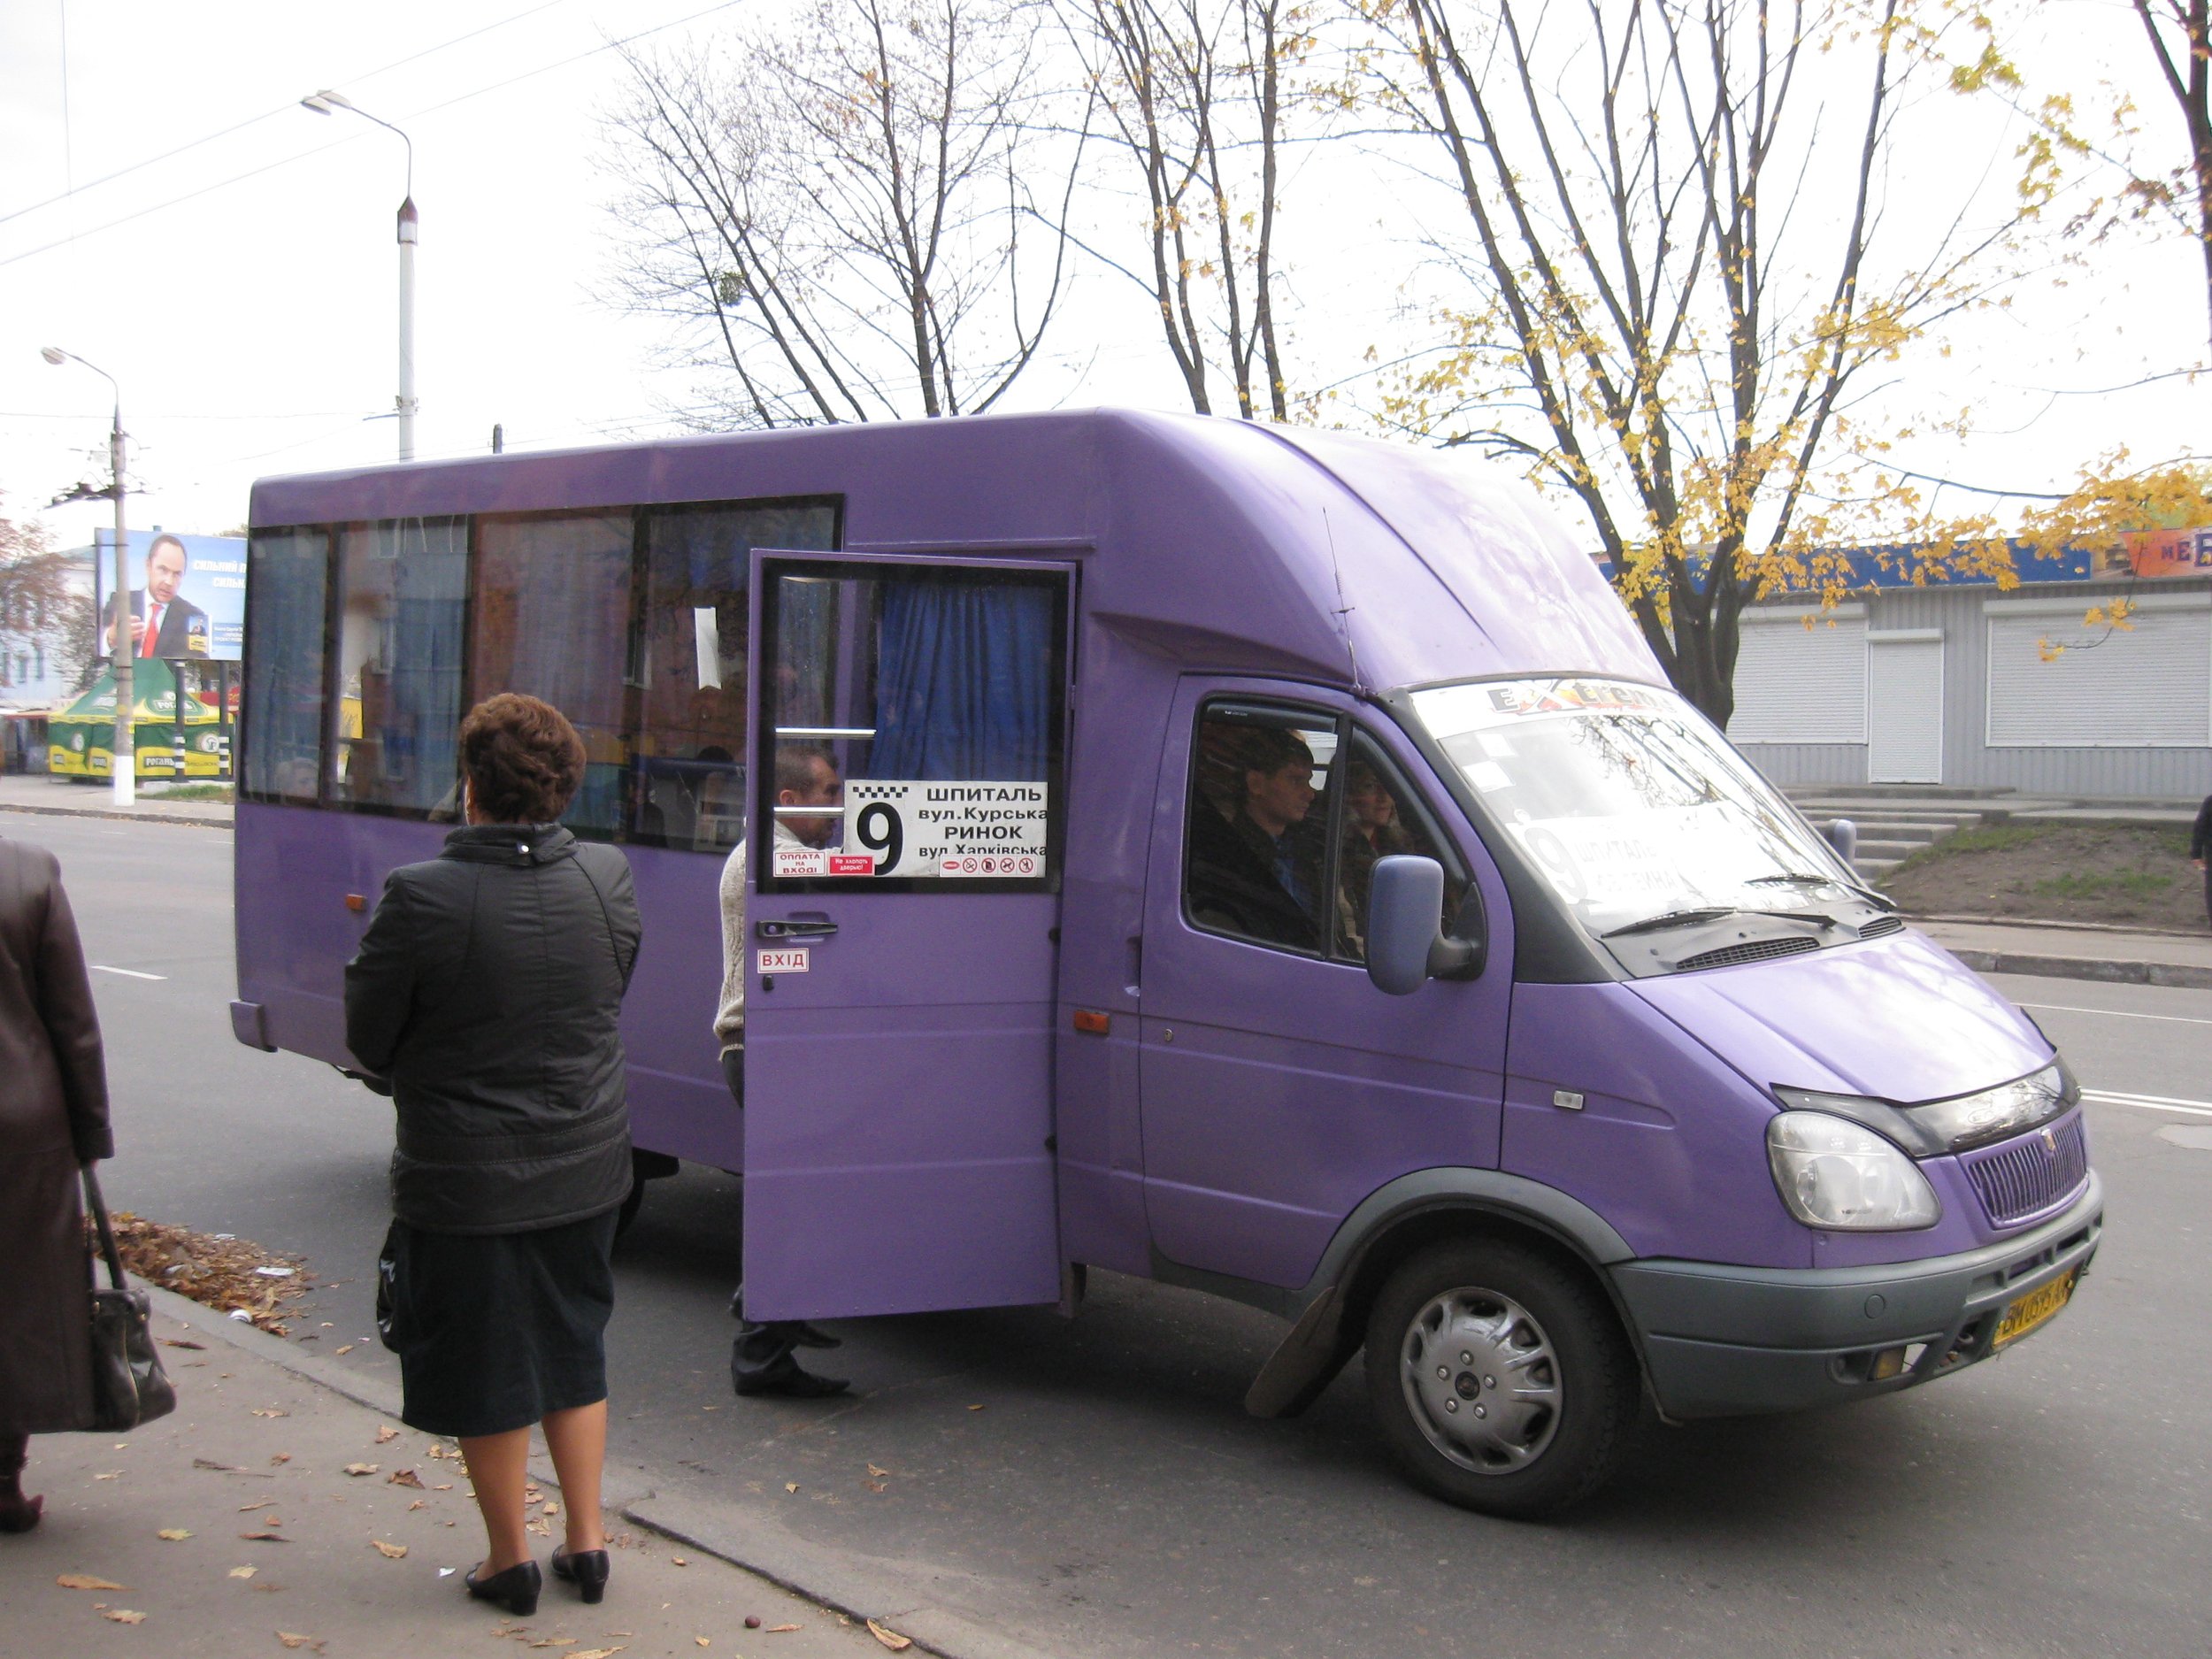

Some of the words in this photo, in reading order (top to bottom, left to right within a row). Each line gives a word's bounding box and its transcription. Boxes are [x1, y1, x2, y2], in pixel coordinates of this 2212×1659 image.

[213, 577, 246, 589] СИЛЬН
[926, 787, 1042, 802] ШПИТАЛЬ
[856, 802, 903, 876] 9
[944, 826, 1023, 840] РИНОК
[1524, 826, 1588, 899] 9
[763, 954, 804, 967] ВХІД
